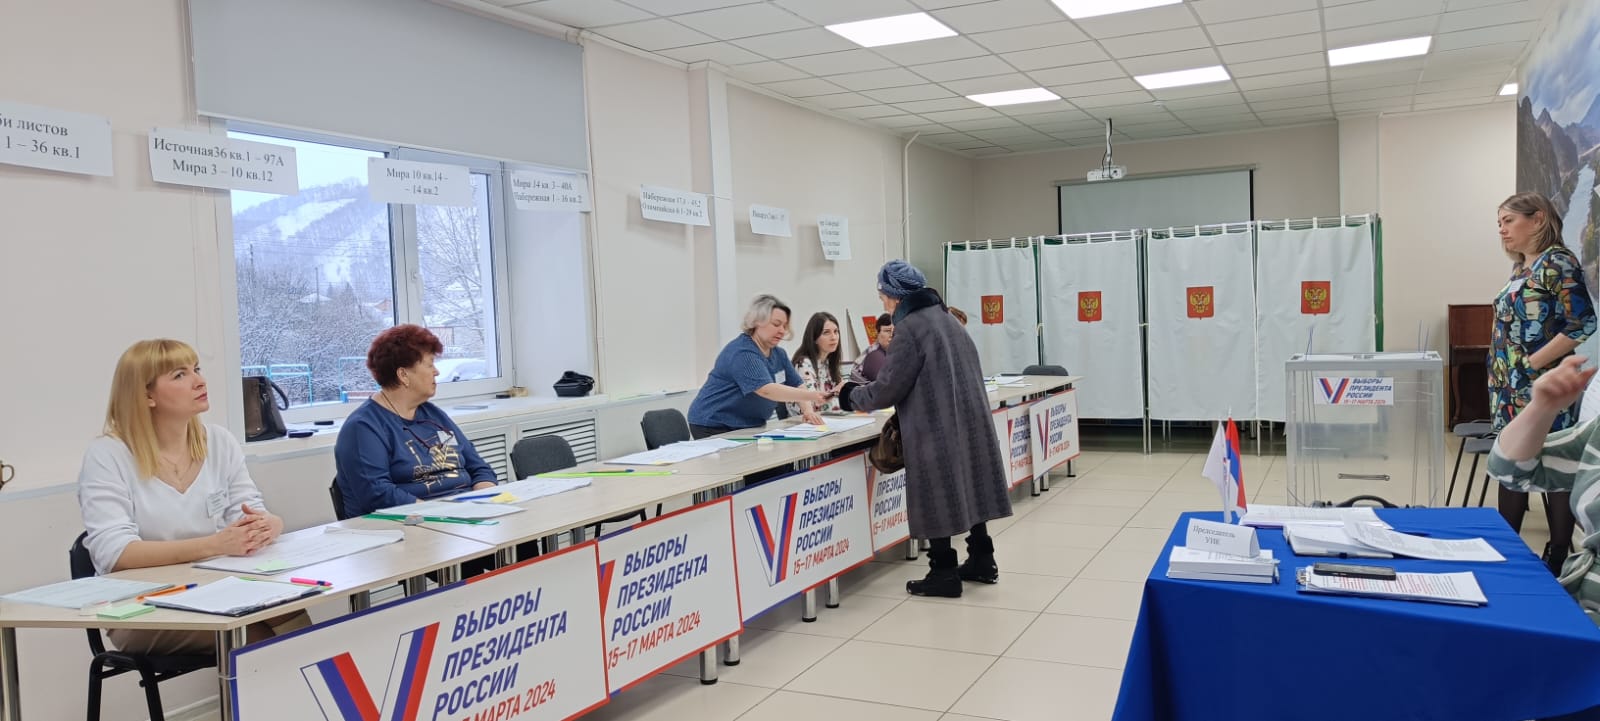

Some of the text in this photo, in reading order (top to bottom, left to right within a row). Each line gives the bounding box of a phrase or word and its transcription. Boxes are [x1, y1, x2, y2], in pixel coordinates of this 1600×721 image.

[17, 120, 68, 136] листов
[31, 139, 48, 153] 36
[53, 146, 80, 159] кв.1
[229, 151, 251, 162] кв.1
[264, 153, 284, 167] 97А
[172, 159, 207, 176] Мира
[211, 163, 217, 175] 3
[231, 166, 243, 178] 10
[246, 170, 273, 182] кв.12
[386, 167, 410, 181] Мира
[412, 169, 421, 179] 10
[513, 179, 531, 189] Мира
[413, 184, 422, 194] 14
[803, 478, 842, 506] ВЫБОРЫ
[874, 494, 902, 517] РОССИИ
[799, 495, 854, 531] ПРЕЗИДЕНТА
[796, 524, 834, 554] РОССИИ
[813, 543, 834, 567] МАРТА
[835, 537, 850, 557] 2024
[623, 534, 688, 577] ВЫБОРЫ
[617, 554, 708, 608] ПРЕЗИДЕНТА
[451, 587, 542, 642] ВЫБОРЫ
[611, 596, 672, 642] РОССИИ
[441, 611, 568, 682] ПРЕЗИДЕНТА
[639, 621, 674, 655] МАРТА
[676, 609, 700, 637] 2024
[432, 662, 519, 721] РОССИИ
[523, 678, 556, 712] 2024
